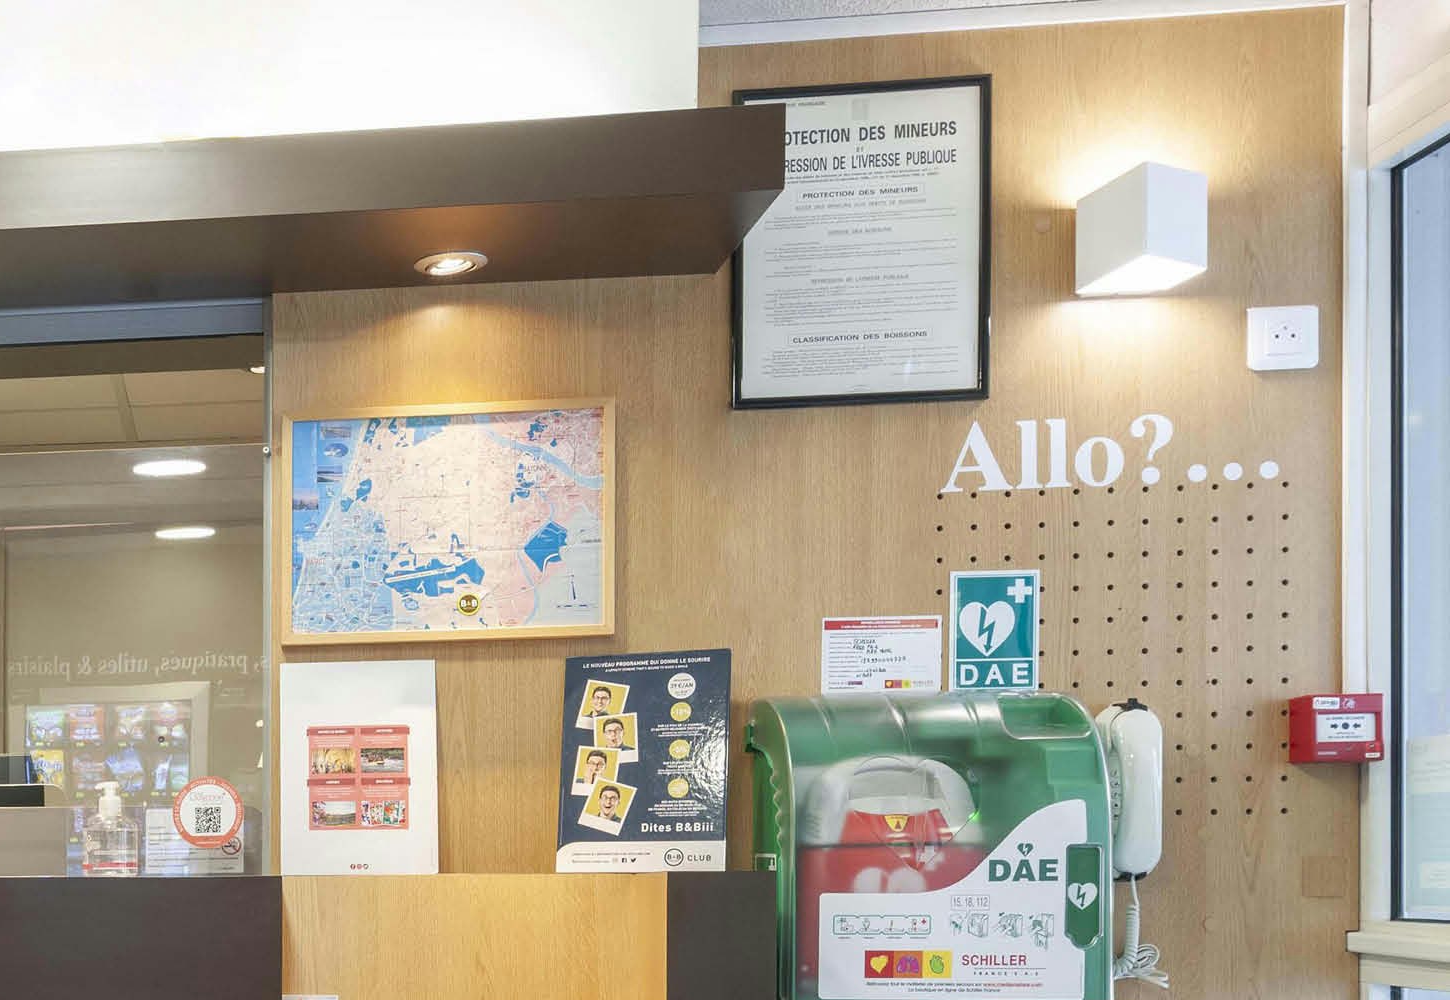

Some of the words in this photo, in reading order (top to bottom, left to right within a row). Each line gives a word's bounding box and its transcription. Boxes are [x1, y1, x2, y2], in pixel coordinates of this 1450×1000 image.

[785, 127, 850, 146] OTECTION
[859, 125, 886, 141] DES
[894, 121, 957, 139] MINEURS
[785, 157, 827, 173] RESSION
[833, 156, 846, 170] DE
[851, 153, 900, 169] L'IVRESSE
[906, 149, 957, 166] PUBLIQUE
[802, 190, 855, 199] PROTECTION
[858, 189, 875, 197] DES
[879, 186, 918, 195] MINEURS
[793, 334, 859, 344] CLASSIFICATION
[884, 331, 927, 339] BOISSONS
[960, 663, 1030, 686] DAE
[641, 823, 672, 833] Dites
[675, 822, 714, 833] B&Biii
[687, 854, 712, 862] CLUB
[988, 859, 1058, 882] DAE
[962, 954, 1027, 966] SCHILLER
